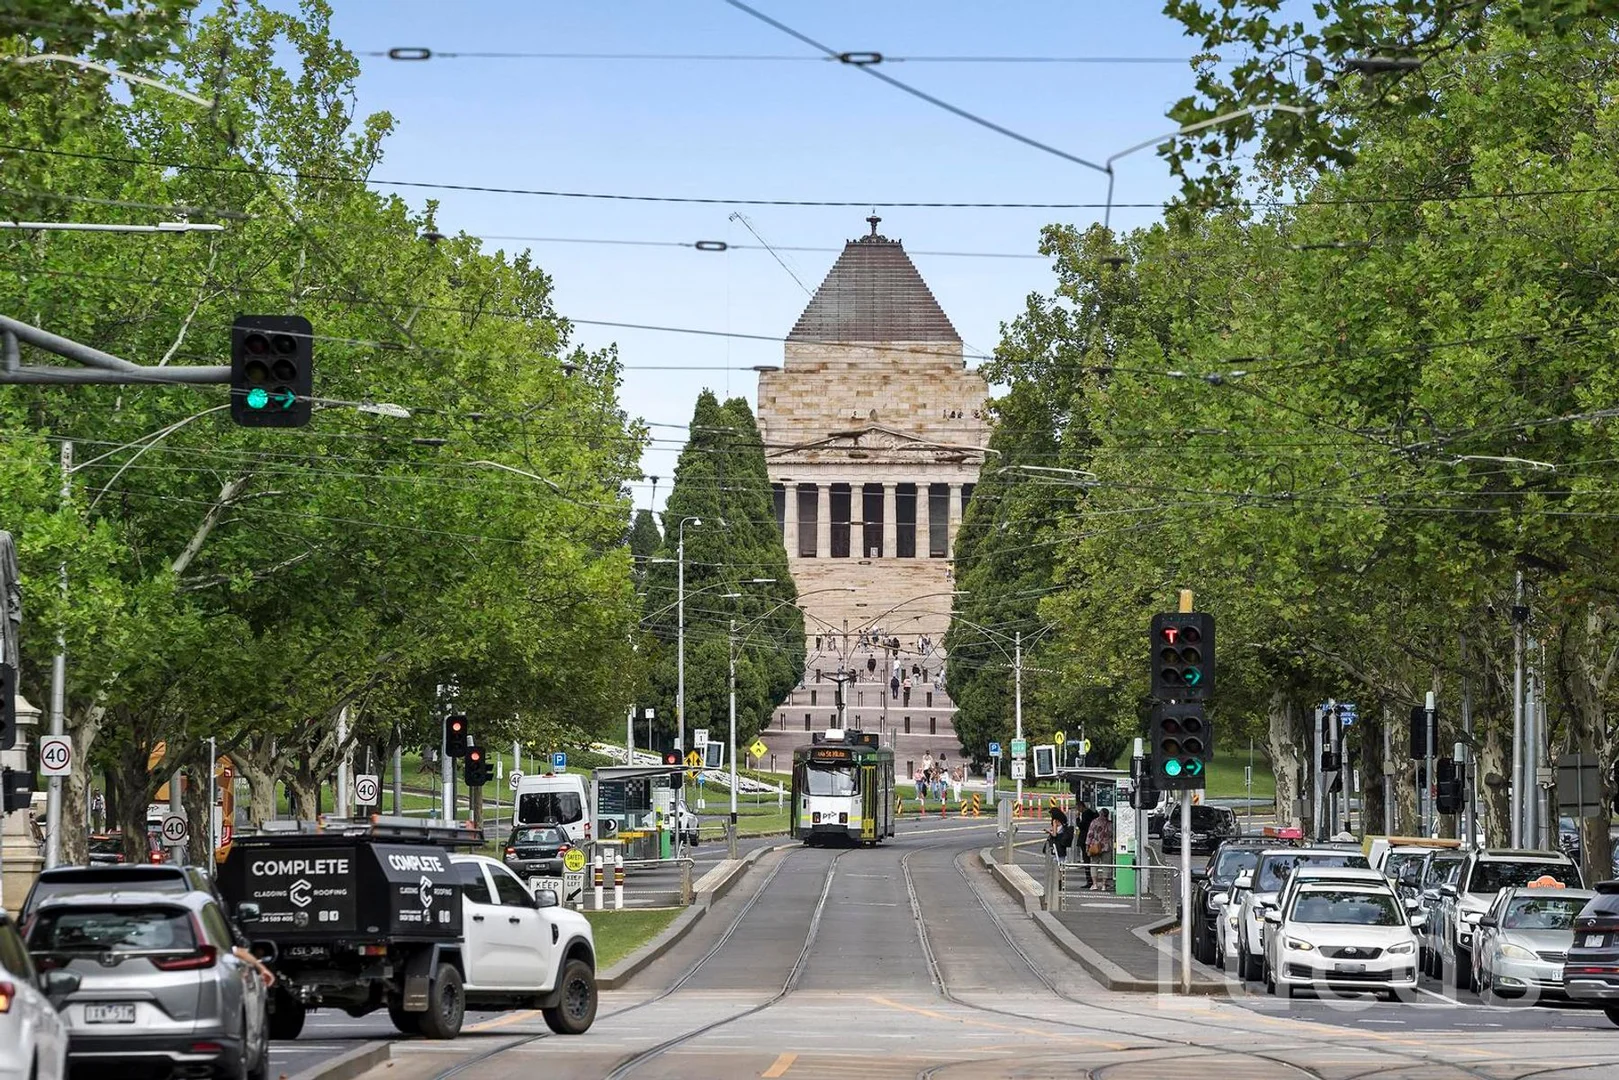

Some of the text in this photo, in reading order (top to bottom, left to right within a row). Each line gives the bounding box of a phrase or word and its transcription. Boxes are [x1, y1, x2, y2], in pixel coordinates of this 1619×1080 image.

[1165, 629, 1178, 644] T
[45, 748, 67, 763] 40
[556, 756, 563, 765] P
[358, 785, 374, 796] 40
[165, 823, 183, 835] 40
[252, 859, 349, 876] COMPLETE
[388, 854, 445, 872] COMPLETE
[536, 881, 559, 889] KEEP
[253, 890, 287, 898] CLADDING
[313, 888, 348, 896] ROOFING
